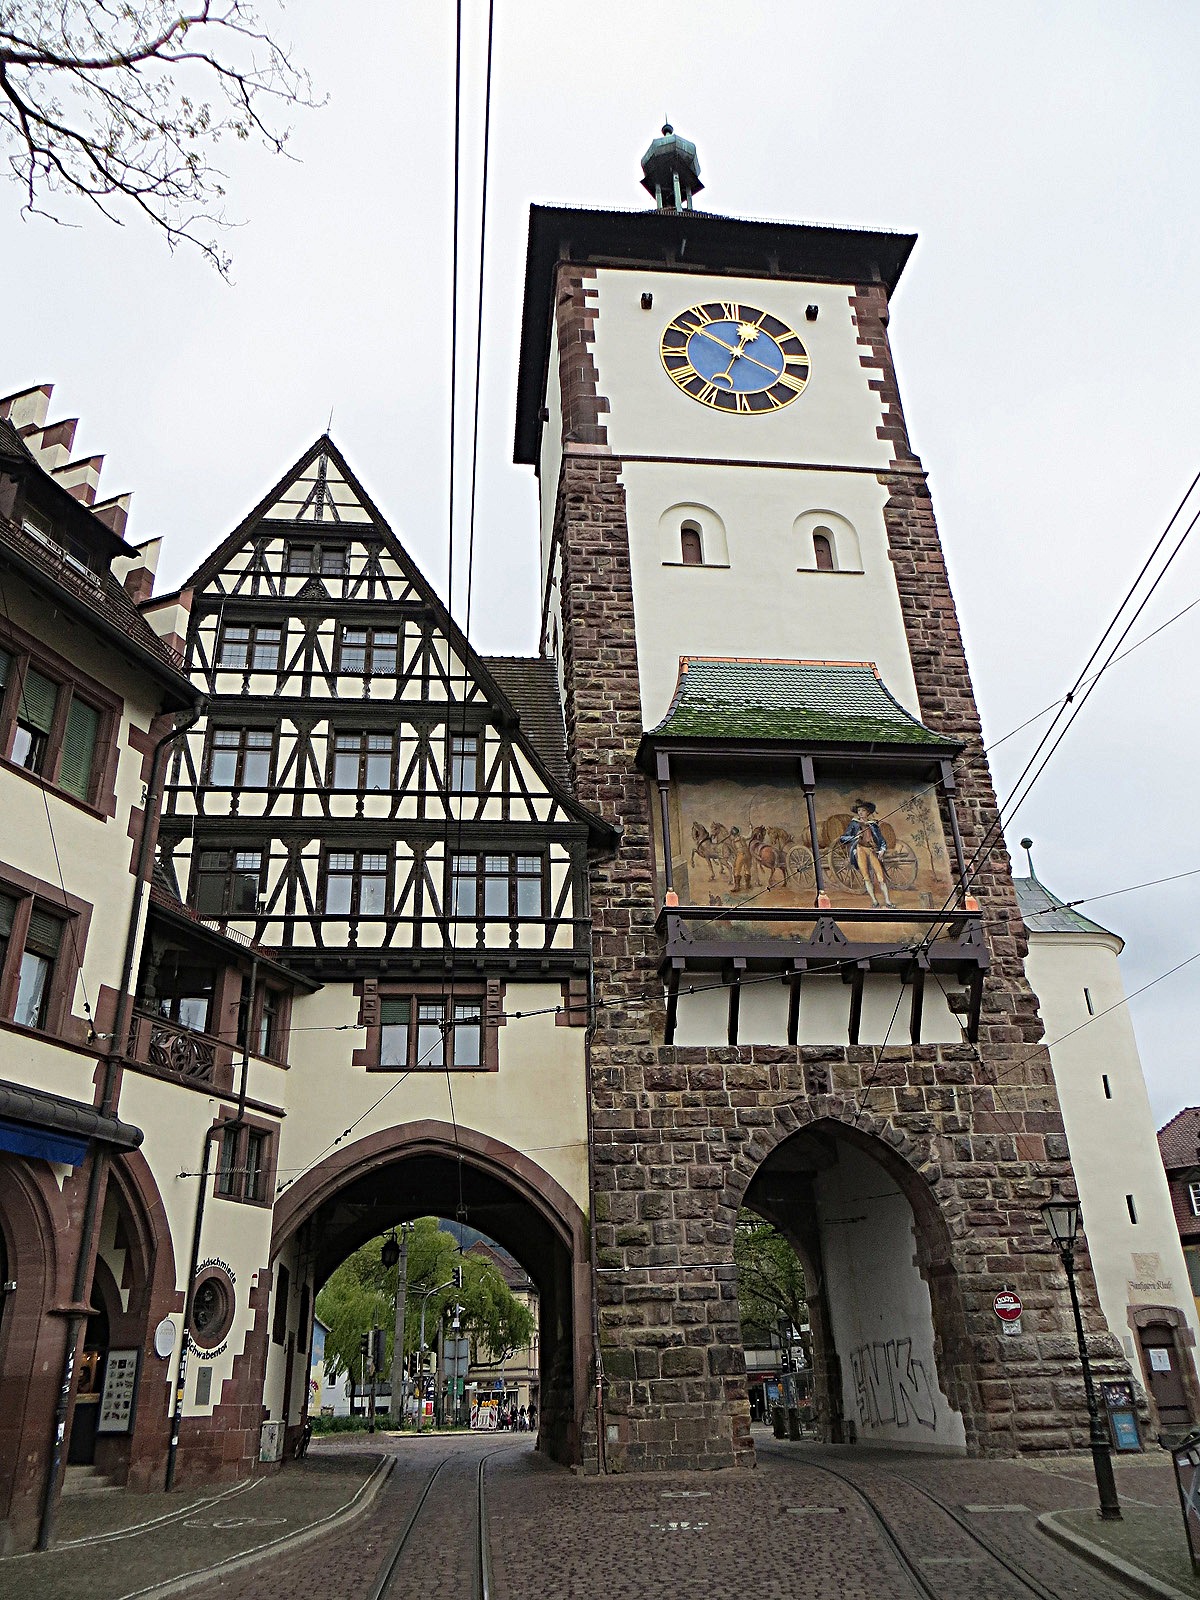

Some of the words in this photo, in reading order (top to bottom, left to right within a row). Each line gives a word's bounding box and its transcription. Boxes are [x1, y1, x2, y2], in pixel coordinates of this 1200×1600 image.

[689, 306, 712, 326] XI
[721, 303, 739, 320] XII
[774, 331, 796, 343] II
[662, 346, 686, 356] IX
[698, 383, 718, 405] VII
[736, 394, 751, 411] VI
[765, 391, 782, 408] V
[195, 1257, 237, 1284] Goldschmiede
[187, 1338, 228, 1360] Schwabentor
